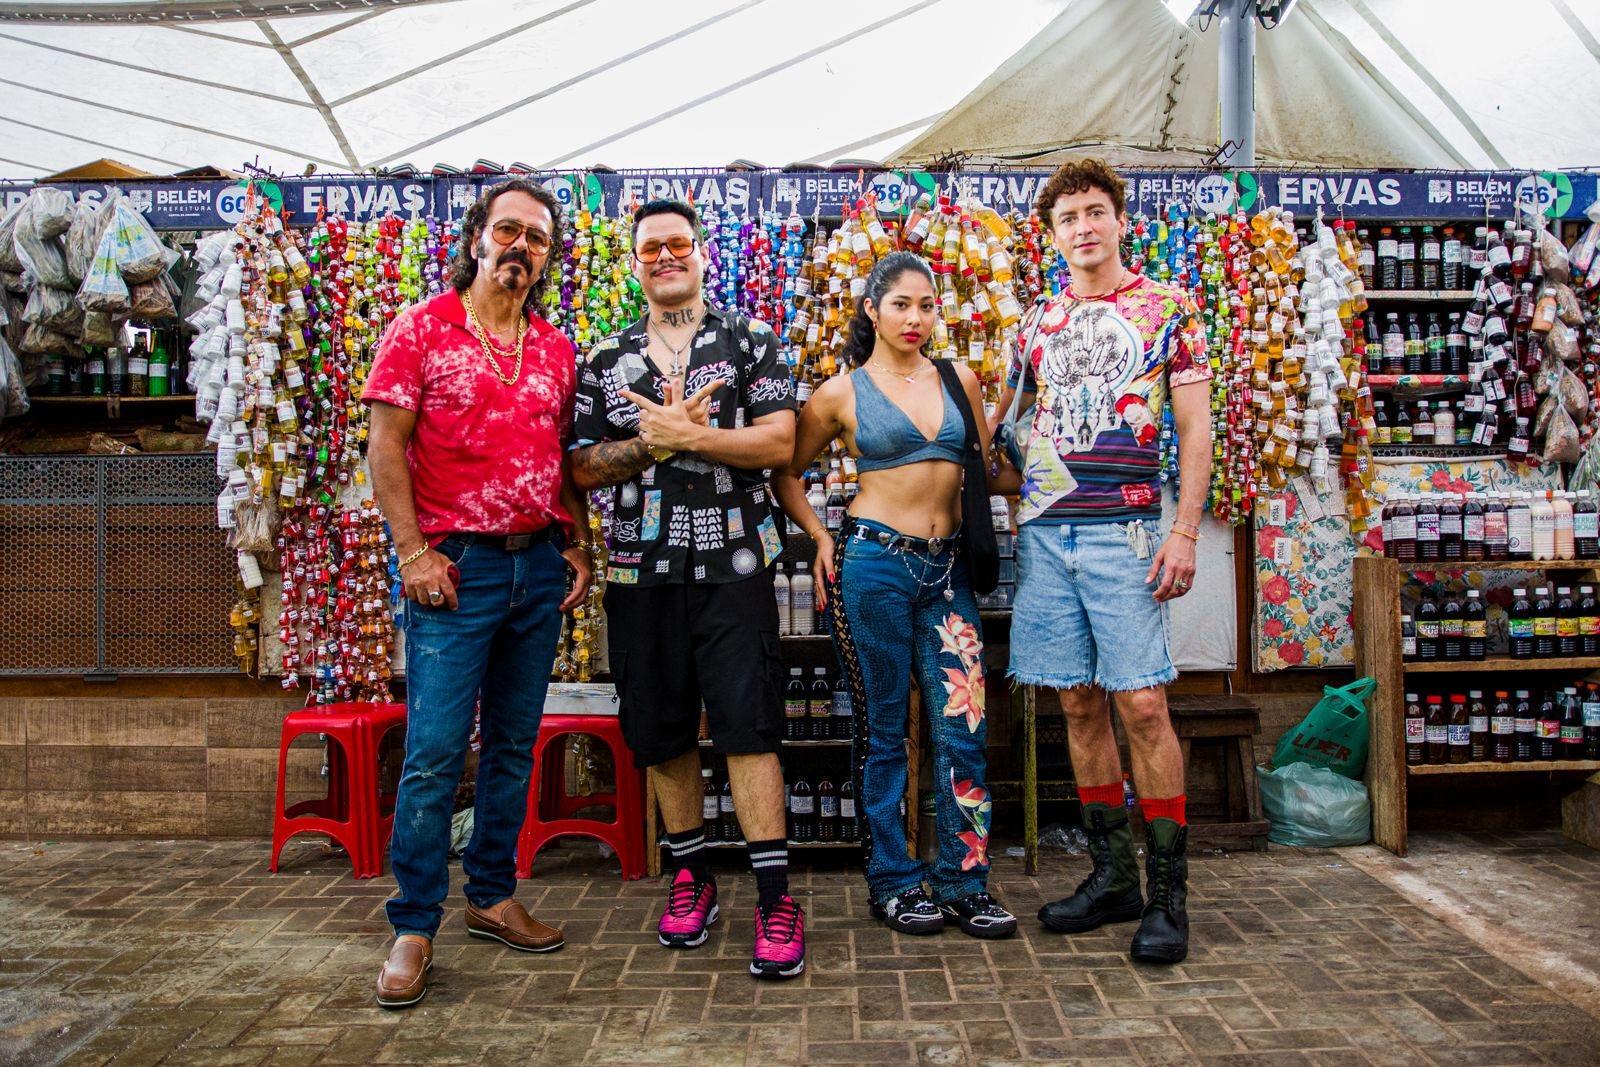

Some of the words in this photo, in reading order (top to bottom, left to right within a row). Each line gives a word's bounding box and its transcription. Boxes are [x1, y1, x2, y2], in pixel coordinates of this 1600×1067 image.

[624, 178, 749, 205] ERVAS
[806, 176, 861, 193] BELÉM
[958, 177, 1049, 204] ERV
[1279, 178, 1401, 205] ERVAS
[1456, 179, 1511, 194] BELÉM
[157, 188, 211, 204] BELÉM
[303, 184, 425, 213] ERVAS
[557, 187, 571, 205] 9
[1521, 187, 1549, 204] 56
[220, 196, 246, 214] 60
